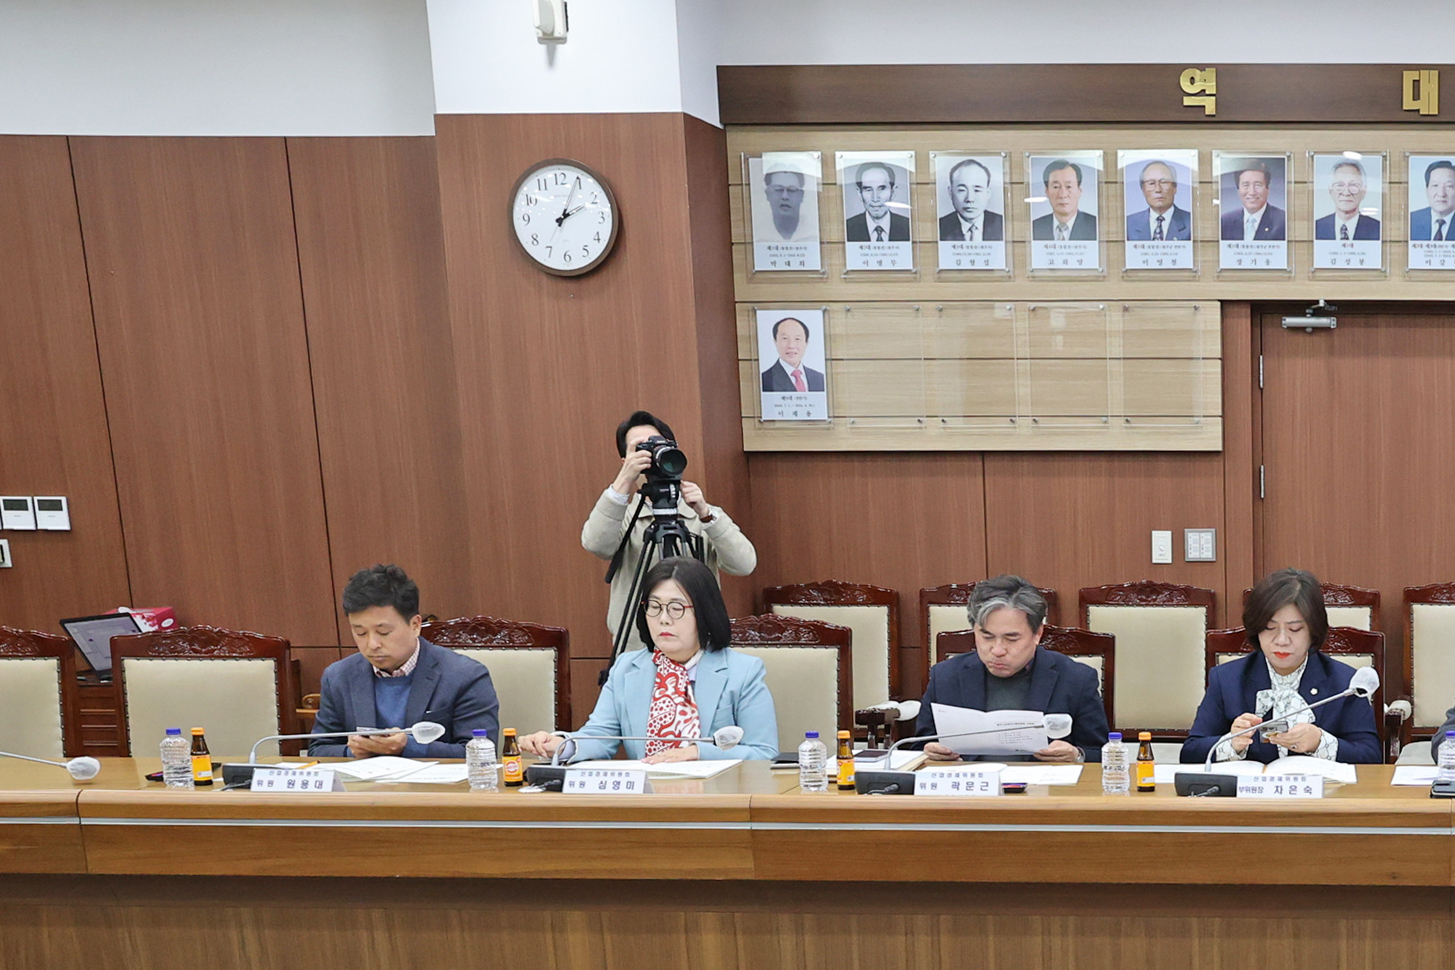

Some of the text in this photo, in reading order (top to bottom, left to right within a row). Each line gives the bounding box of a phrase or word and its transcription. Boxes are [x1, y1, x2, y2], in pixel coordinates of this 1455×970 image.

[1179, 67, 1217, 116] 역
[1403, 69, 1439, 116] 대
[537, 178, 548, 191] 11
[554, 172, 568, 186] 12
[577, 177, 582, 190] 1
[525, 194, 538, 206] 10
[590, 192, 598, 204] 2
[522, 213, 531, 226] 9
[598, 211, 605, 224] 3
[531, 233, 539, 246] 8
[593, 231, 601, 243] 4
[545, 246, 553, 258] 7
[563, 250, 572, 263] 6
[582, 245, 590, 258] 5
[256, 778, 324, 789] 위원 원용대
[568, 780, 635, 790] 위원 심영미
[919, 782, 938, 790] 위원
[1238, 785, 1313, 795] 부위원장 차은숙
